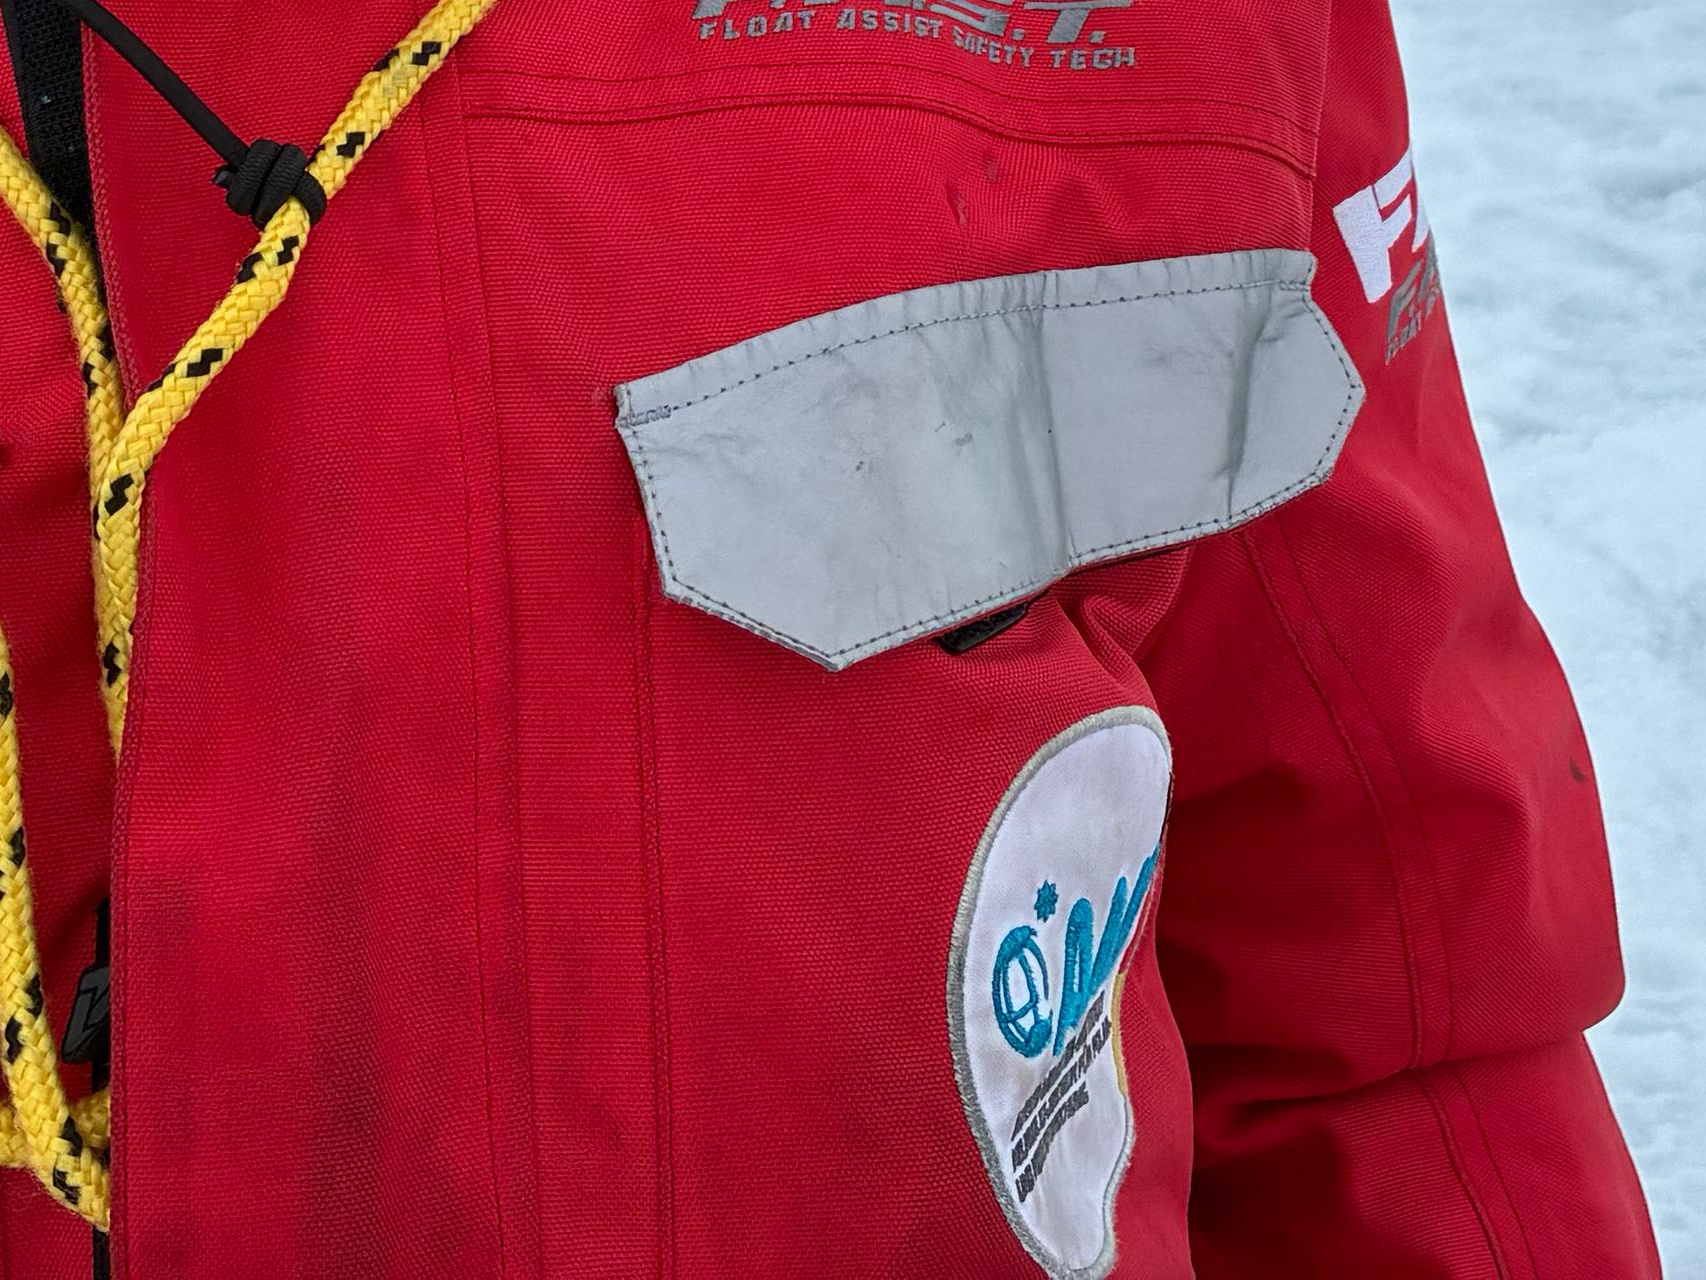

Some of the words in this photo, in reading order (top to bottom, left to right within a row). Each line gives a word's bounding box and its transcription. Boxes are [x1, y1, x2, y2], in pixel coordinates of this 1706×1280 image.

[698, 9, 817, 40] FLOAT
[836, 7, 942, 38] ASSIST
[951, 25, 1036, 68] SAFETY
[1050, 46, 1136, 70] TECH
